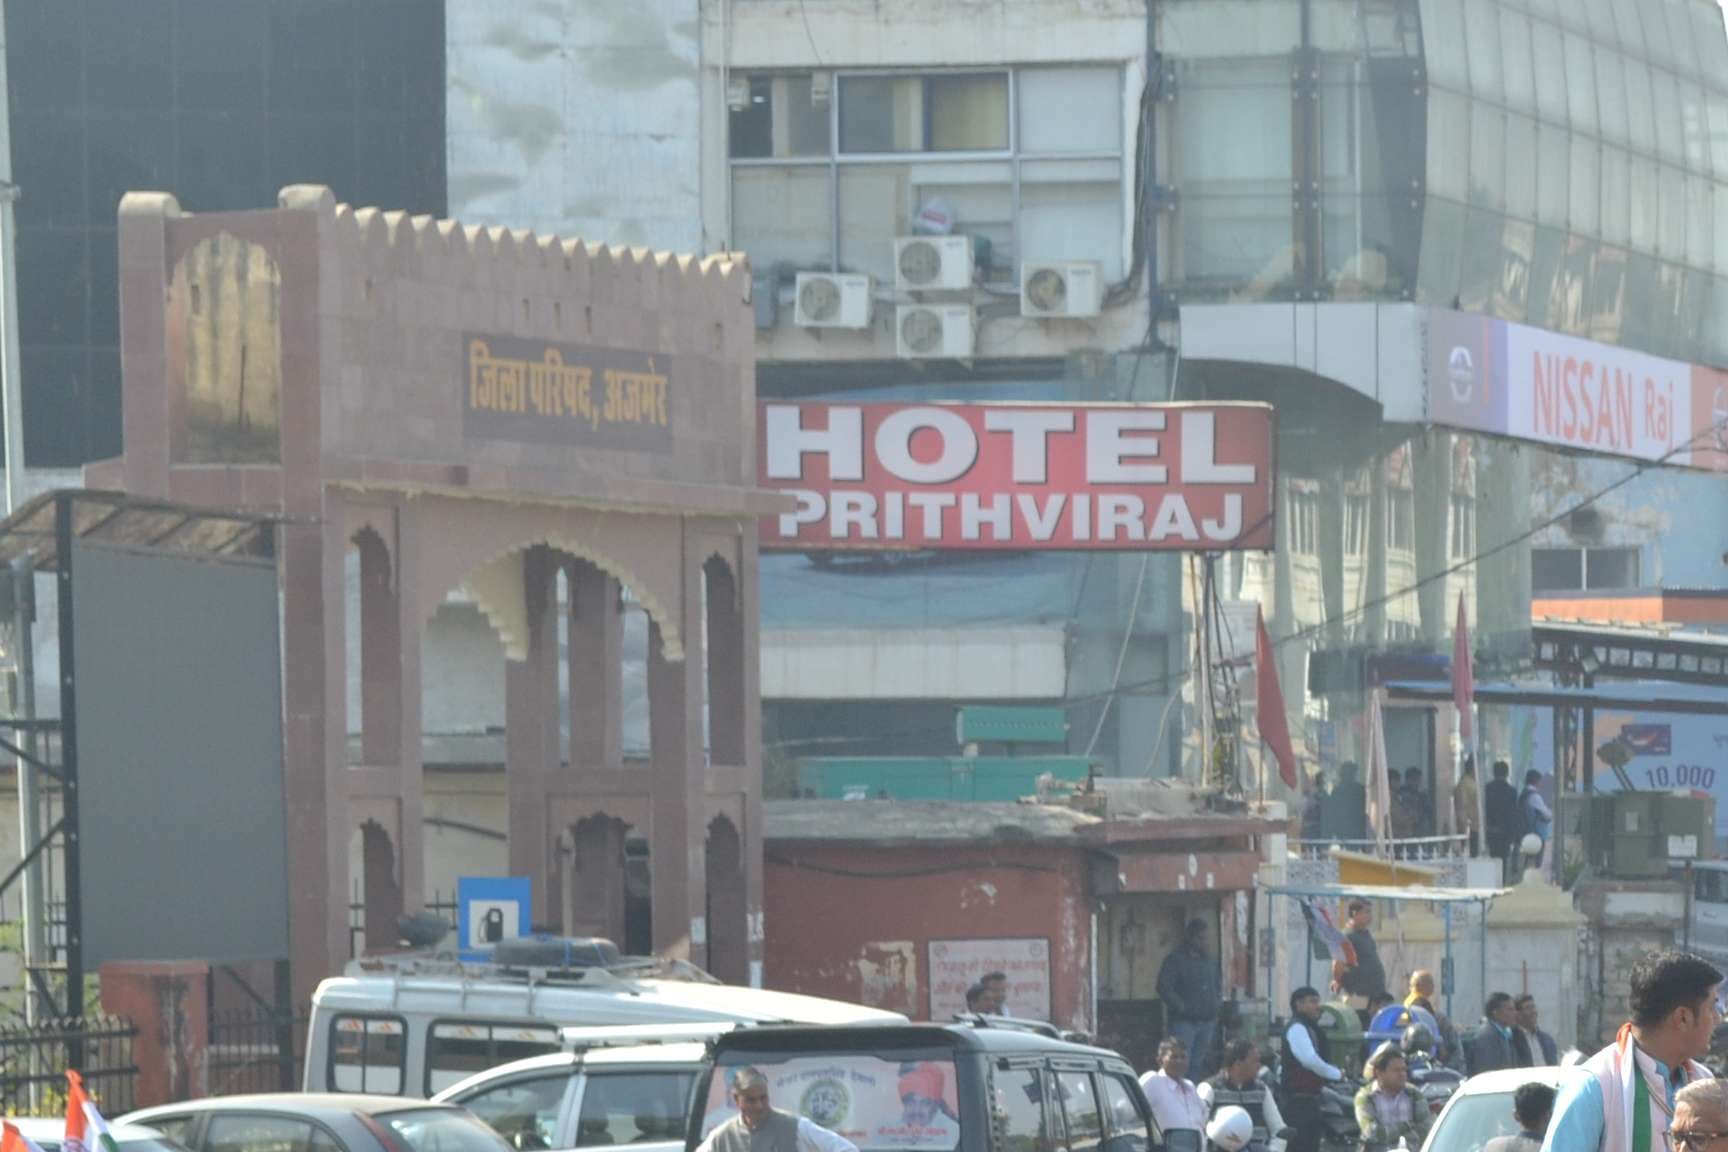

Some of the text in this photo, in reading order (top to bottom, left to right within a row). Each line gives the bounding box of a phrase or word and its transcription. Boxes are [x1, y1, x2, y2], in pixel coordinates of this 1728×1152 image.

[470, 339, 526, 412] जिला
[604, 352, 667, 427] अजमेर
[1533, 351, 1632, 449] NISSAN
[766, 404, 1257, 484] HOTEL
[777, 489, 1243, 542] PRITHVIRAJ
